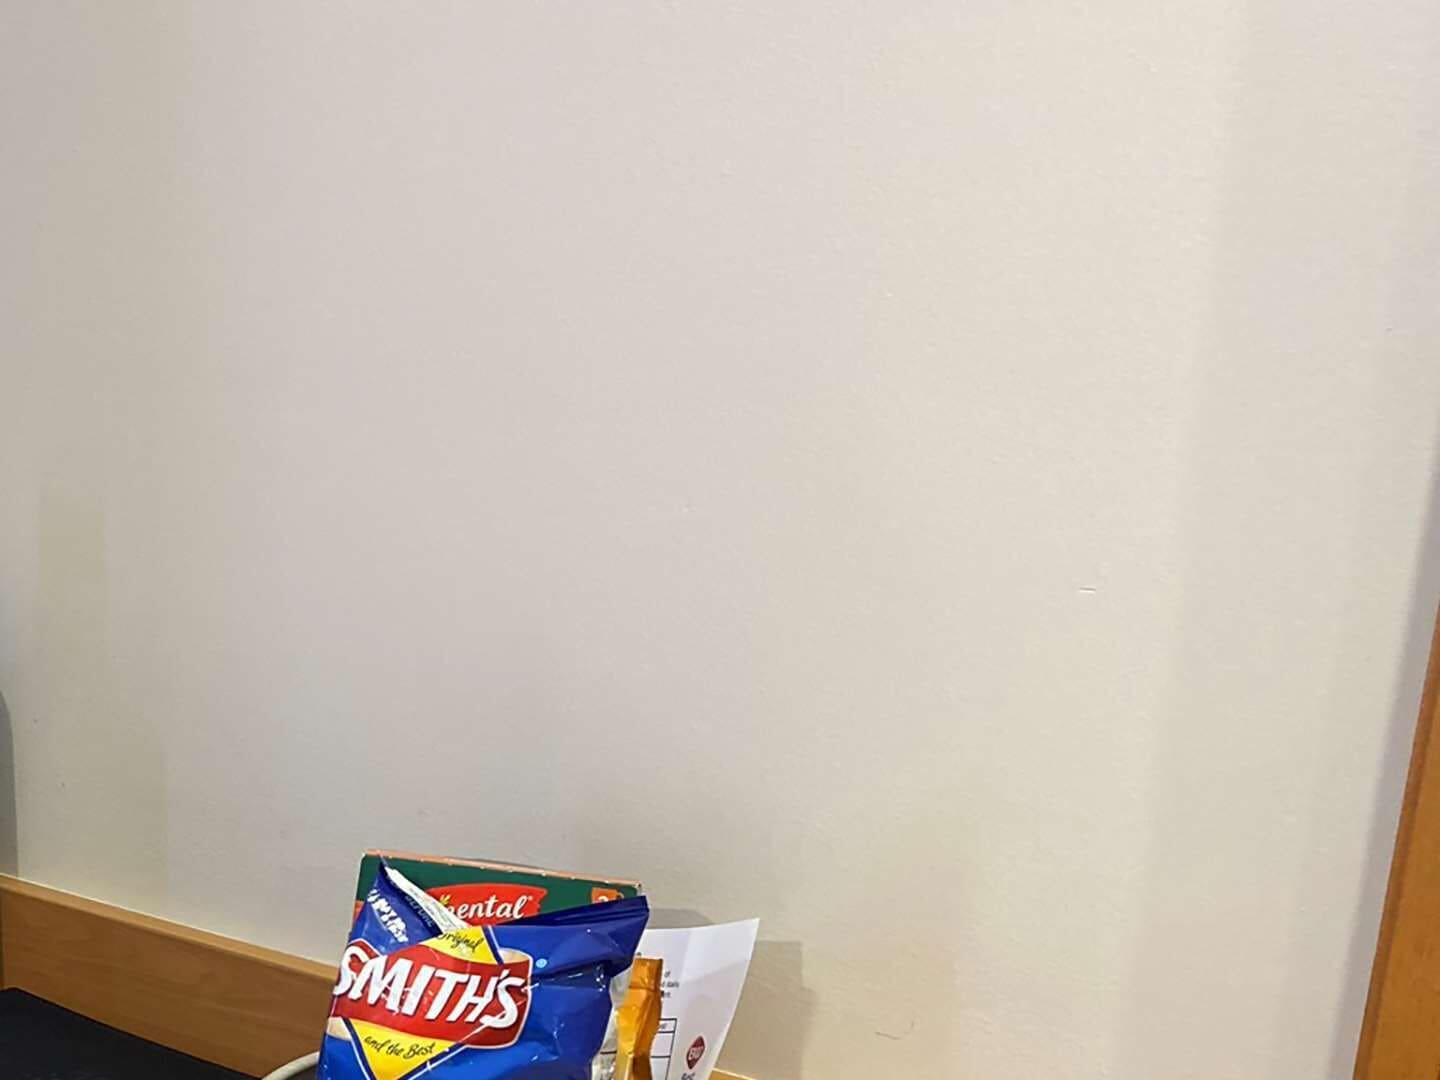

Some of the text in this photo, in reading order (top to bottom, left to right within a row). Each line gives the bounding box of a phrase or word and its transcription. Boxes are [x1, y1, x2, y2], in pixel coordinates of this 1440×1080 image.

[333, 945, 524, 1029] SMITH'S
[364, 1036, 436, 1059] and the Best
